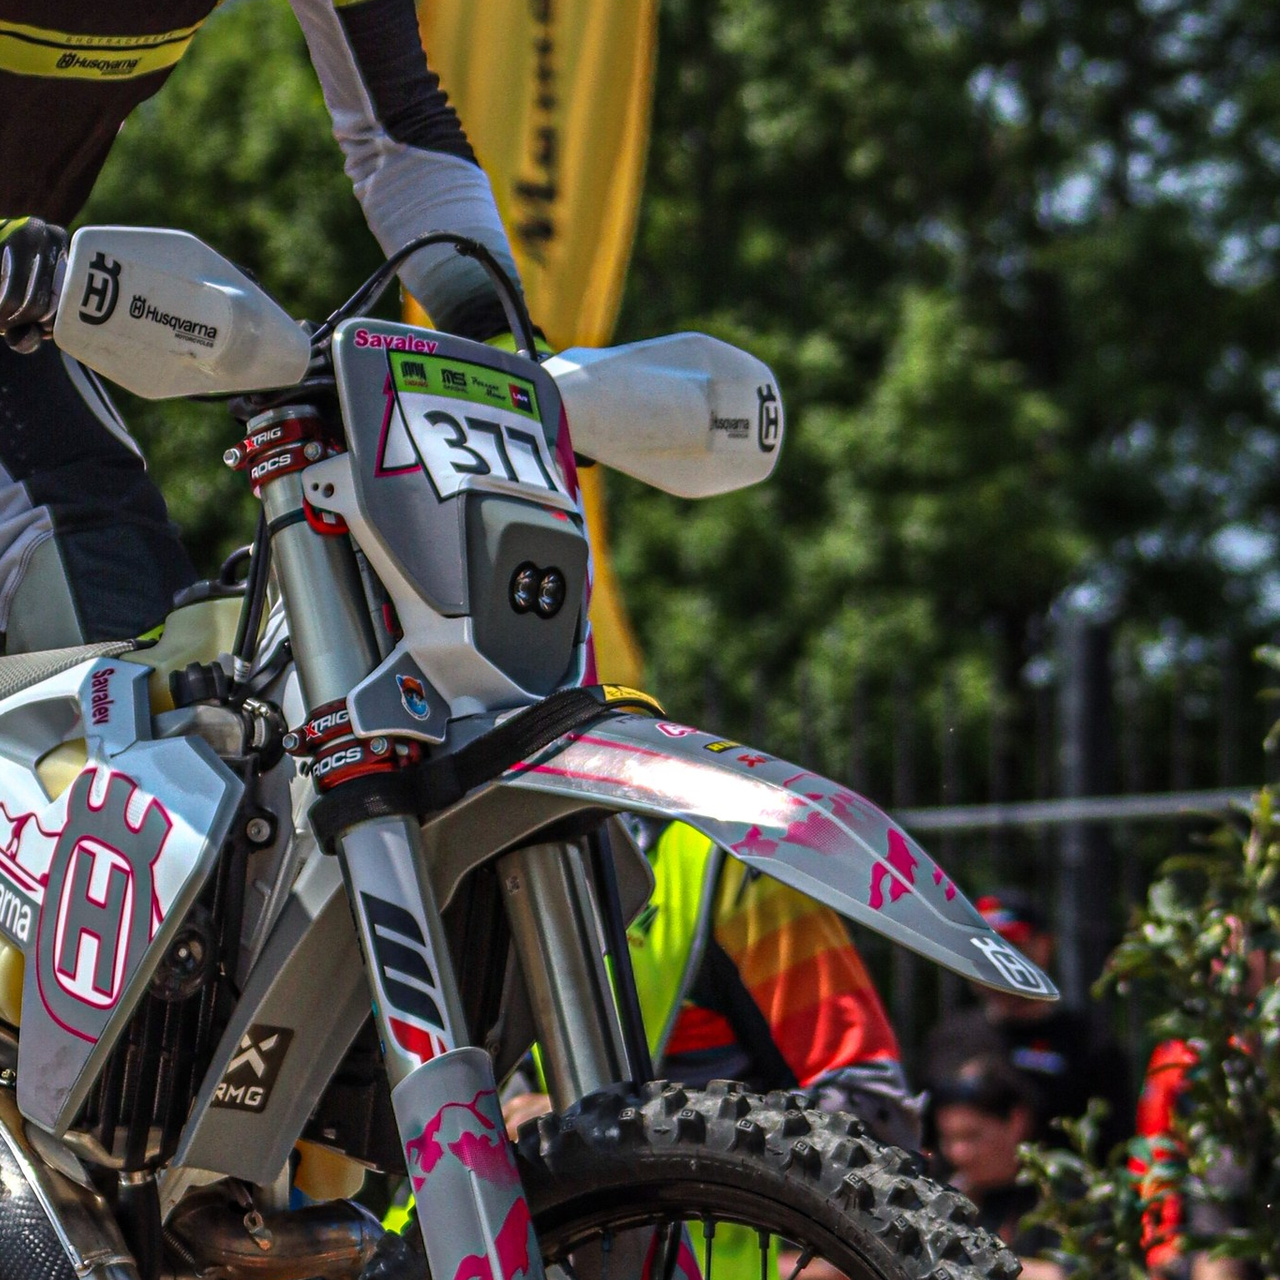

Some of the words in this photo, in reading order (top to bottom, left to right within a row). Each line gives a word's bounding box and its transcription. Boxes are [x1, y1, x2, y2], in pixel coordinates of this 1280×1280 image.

[72, 57, 140, 72] Husqvarna
[145, 305, 218, 340] Husqvarna
[174, 332, 215, 349] MOTORCYCLES
[353, 328, 439, 355] Savalev
[423, 409, 559, 493] 377
[251, 453, 292, 480] ROCS
[91, 667, 115, 726] Savalev
[311, 745, 362, 778] ROCS
[212, 1082, 265, 1107] RMG
